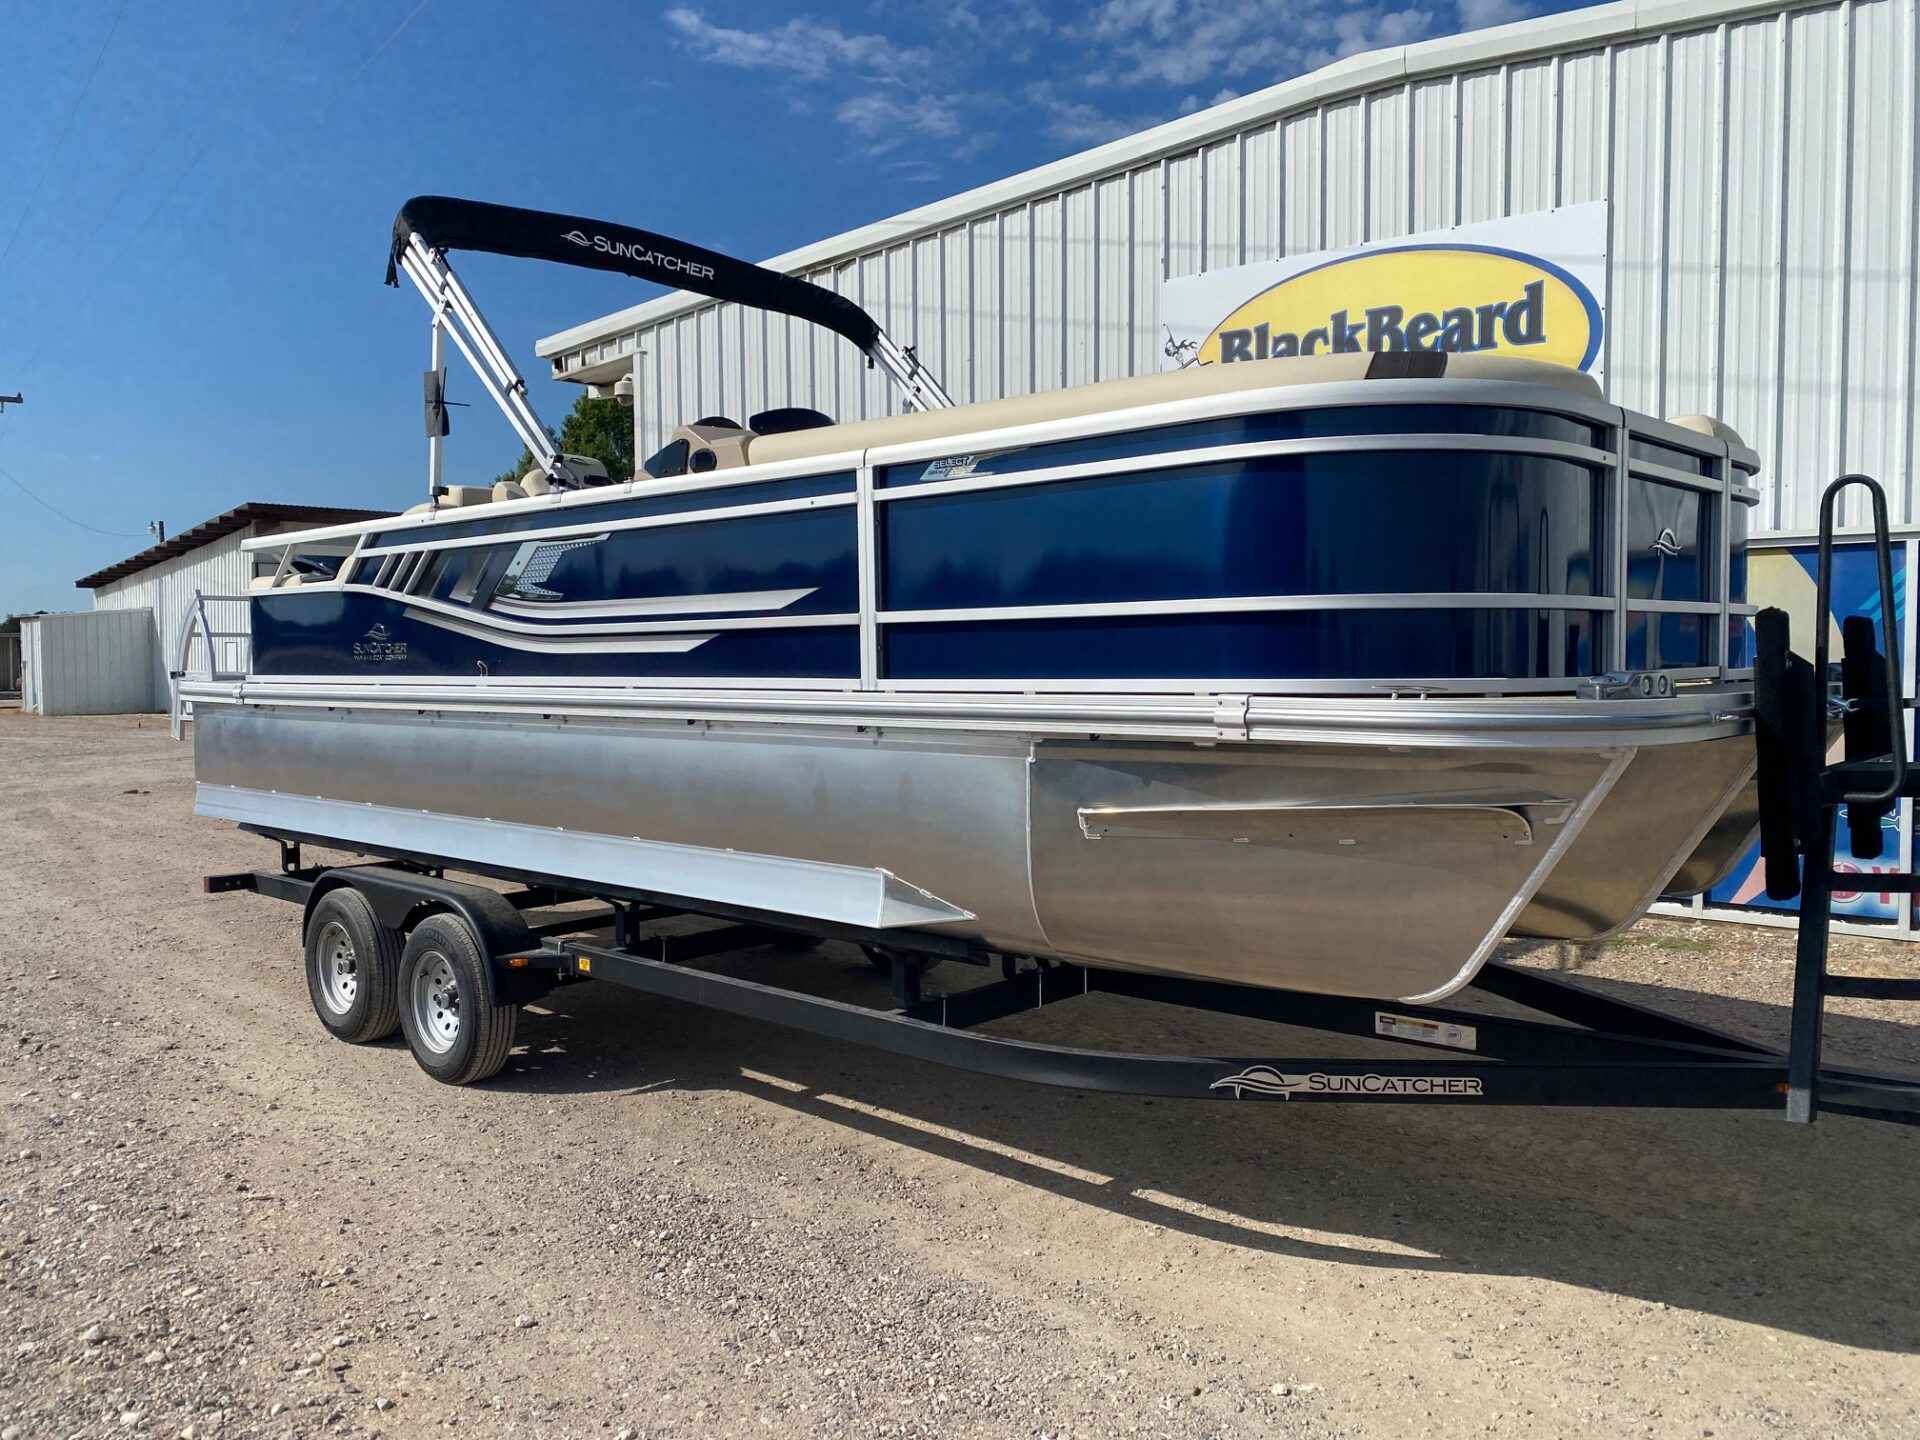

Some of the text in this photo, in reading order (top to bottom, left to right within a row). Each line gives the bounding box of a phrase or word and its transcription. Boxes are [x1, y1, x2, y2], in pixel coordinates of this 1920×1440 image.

[593, 235, 714, 280] SUNCATCHER
[1218, 278, 1547, 364] BlackBeard
[1308, 1074, 1482, 1093] SUNCATCHER
